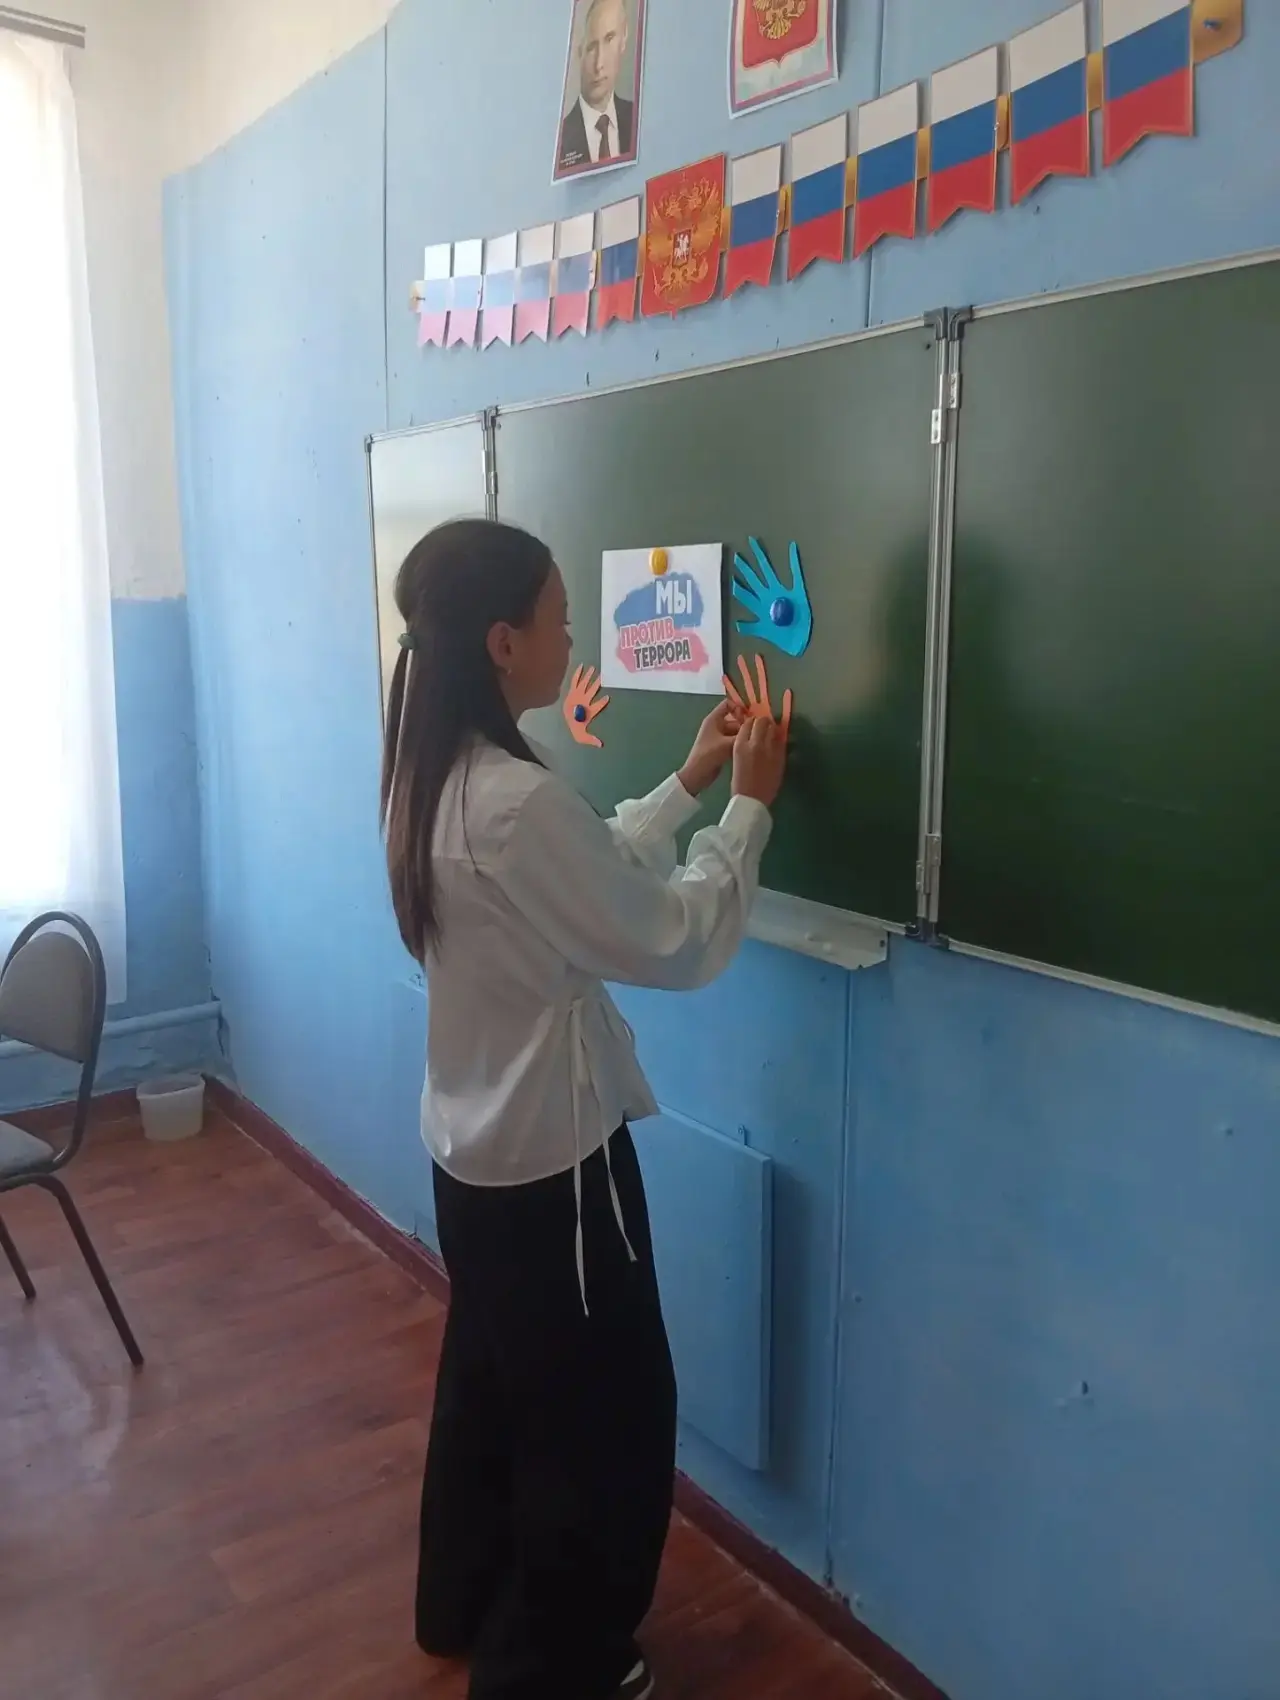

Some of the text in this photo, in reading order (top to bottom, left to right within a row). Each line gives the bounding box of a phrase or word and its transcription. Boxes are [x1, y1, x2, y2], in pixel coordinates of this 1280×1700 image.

[655, 579, 692, 615] МЫ
[620, 617, 674, 649] ПРОТИВ
[634, 639, 692, 669] ТЕРРОРА
